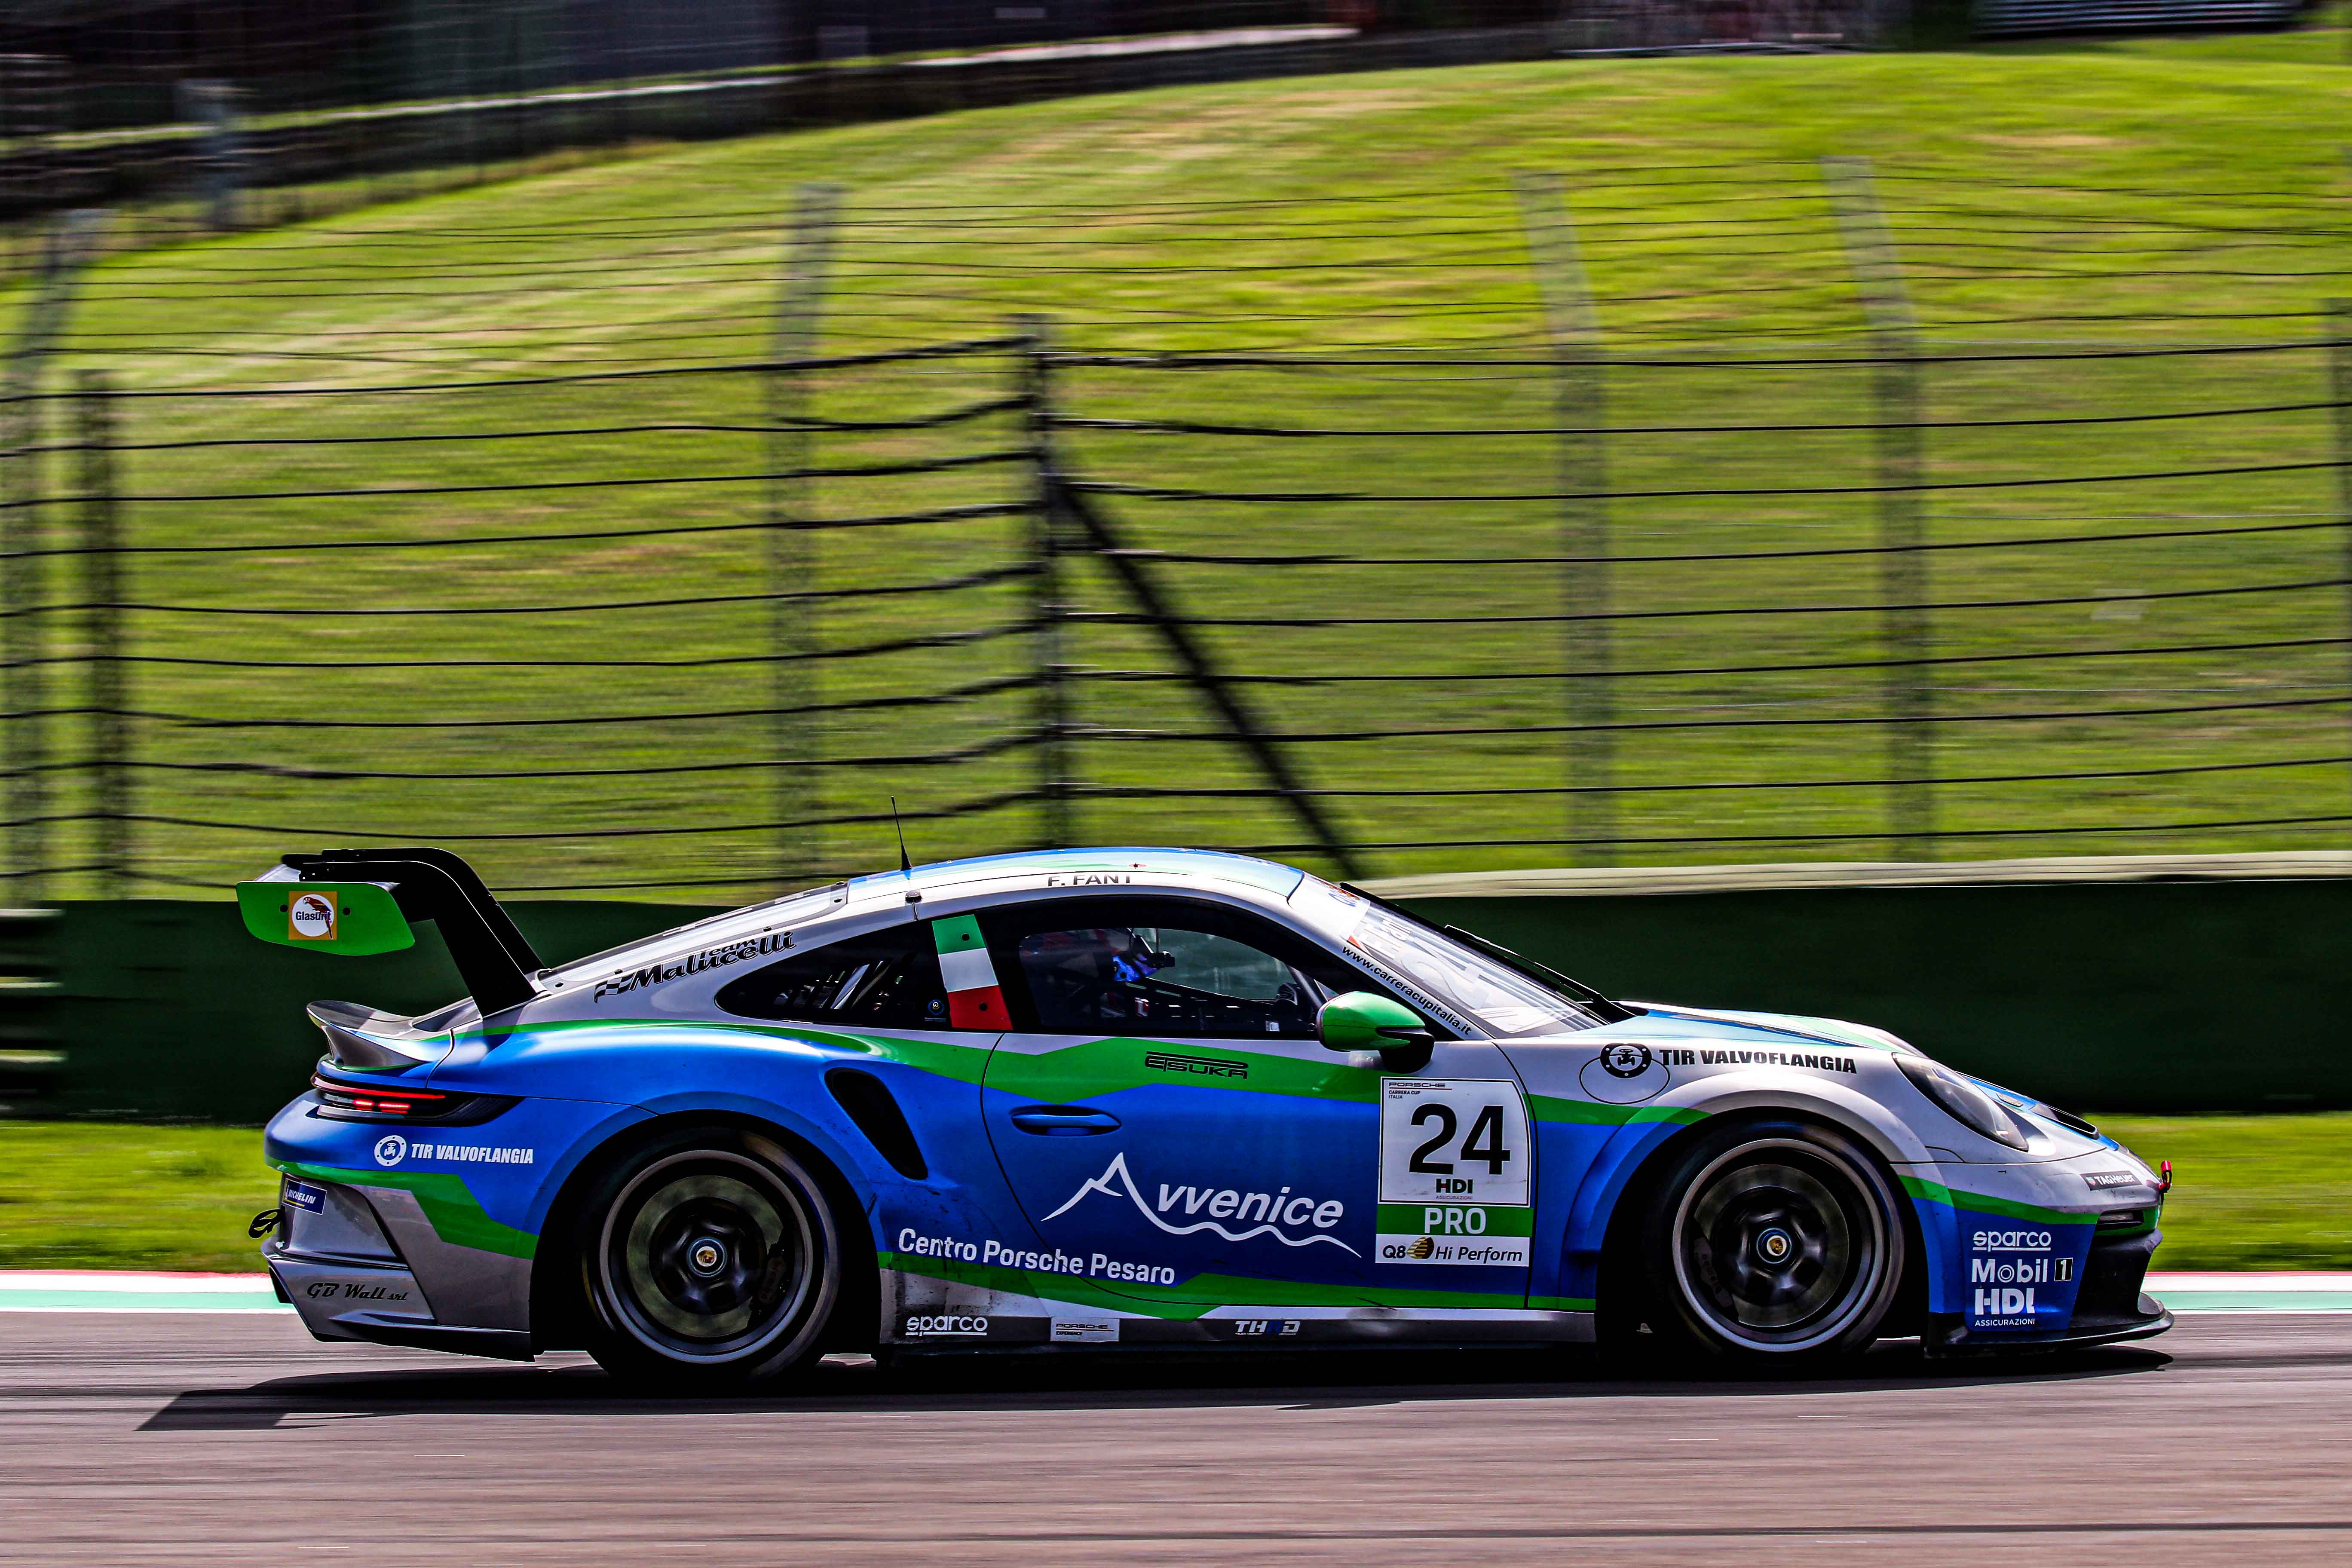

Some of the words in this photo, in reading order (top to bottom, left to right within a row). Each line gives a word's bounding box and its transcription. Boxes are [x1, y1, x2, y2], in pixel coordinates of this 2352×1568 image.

[629, 931, 796, 991] Malucelli
[1342, 946, 1471, 1036] www.carreracupitalia.it
[1660, 1049, 1695, 1066] TIR
[1700, 1050, 1857, 1073] VALVOFLANGIA
[1409, 1103, 1510, 1175] 24
[411, 1143, 433, 1159] TIR
[436, 1145, 533, 1164] VALVOFLANGIA
[288, 1189, 316, 1204] MICHELIN
[1436, 1178, 1473, 1194] HDI
[1424, 1207, 1486, 1234] PRO
[1382, 1245, 1406, 1260] Q8
[1973, 1231, 2052, 1252] sparco
[899, 1228, 977, 1262] Centro
[983, 1240, 1084, 1275] Porsche
[1090, 1253, 1176, 1284] Pesaro
[1435, 1245, 1454, 1260] Hi
[1458, 1247, 1522, 1264] Perform
[1971, 1259, 2048, 1283] Mobil
[307, 1283, 340, 1298] GB
[344, 1283, 387, 1299] Wall
[387, 1292, 408, 1300] srl
[1975, 1288, 2035, 1315] HDI
[906, 1314, 988, 1337] sparco
[1975, 1318, 2035, 1326] ASSICURAZIONI
